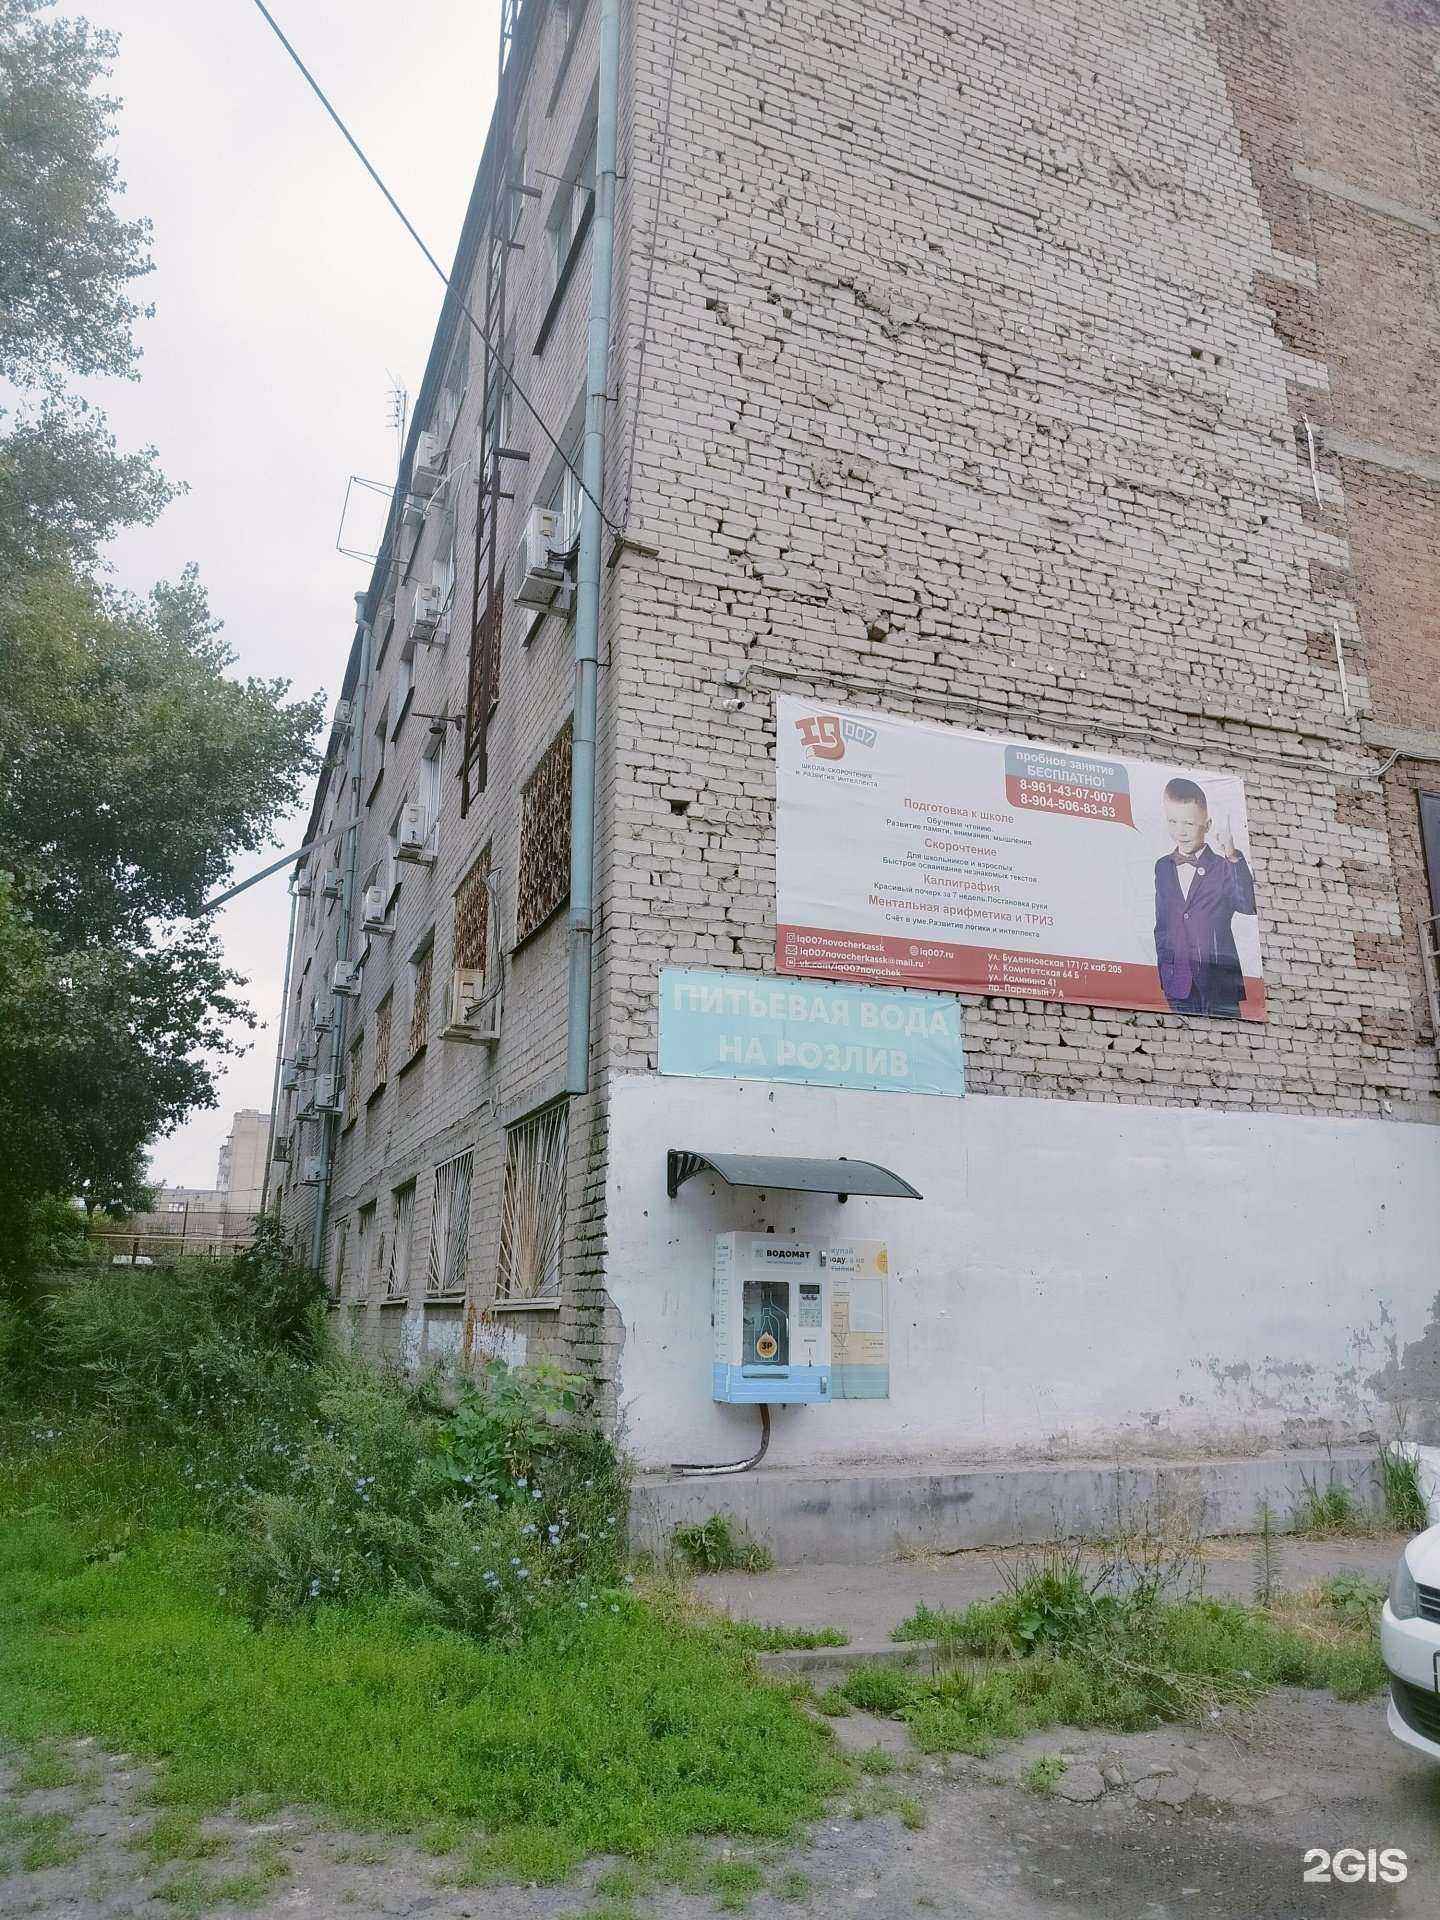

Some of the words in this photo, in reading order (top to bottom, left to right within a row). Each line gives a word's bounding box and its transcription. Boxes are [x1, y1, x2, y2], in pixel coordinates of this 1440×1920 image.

[1016, 751, 1066, 767] пробное
[1069, 760, 1115, 776] занятие
[837, 776, 878, 788] интеллекта
[1027, 765, 1105, 788] БЕСПЛАТНО!
[1019, 779, 1115, 804] 8-961-43-07-007
[903, 798, 968, 818] Подготовка
[971, 810, 977, 818] к
[980, 811, 1015, 824] школе
[1020, 793, 1116, 818] 8-904-506-83-83
[886, 818, 921, 830] Развитие
[926, 816, 963, 828] Обучение
[906, 851, 922, 860] Для
[924, 838, 997, 857] Скорочтение
[882, 856, 917, 867] Быстрое
[923, 874, 1000, 893] Каллиграфия
[868, 894, 940, 913] Ментальная
[943, 905, 1012, 921] арифметика
[1015, 914, 1022, 923] и
[1024, 913, 1054, 926] ТРИЗ
[885, 913, 904, 922] Счёт
[919, 947, 954, 960] iq007.ru
[988, 953, 1000, 962] ул.
[1090, 963, 1106, 972] каб
[1107, 964, 1122, 974] 205
[988, 963, 1001, 972] ул.
[1003, 964, 1061, 978] Комитетская
[1062, 969, 1074, 978] 64
[988, 974, 1001, 982] ул.
[1003, 973, 1046, 987] Калинина
[988, 984, 1002, 993] пр.
[1005, 984, 1049, 997] Парковый
[672, 983, 851, 1028] ПИТЬЕВАЯ
[860, 1002, 950, 1039] ВОДА
[719, 1033, 769, 1066] НА
[776, 1039, 909, 1078] РОЗЛИВ
[766, 1249, 811, 1259] водомат
